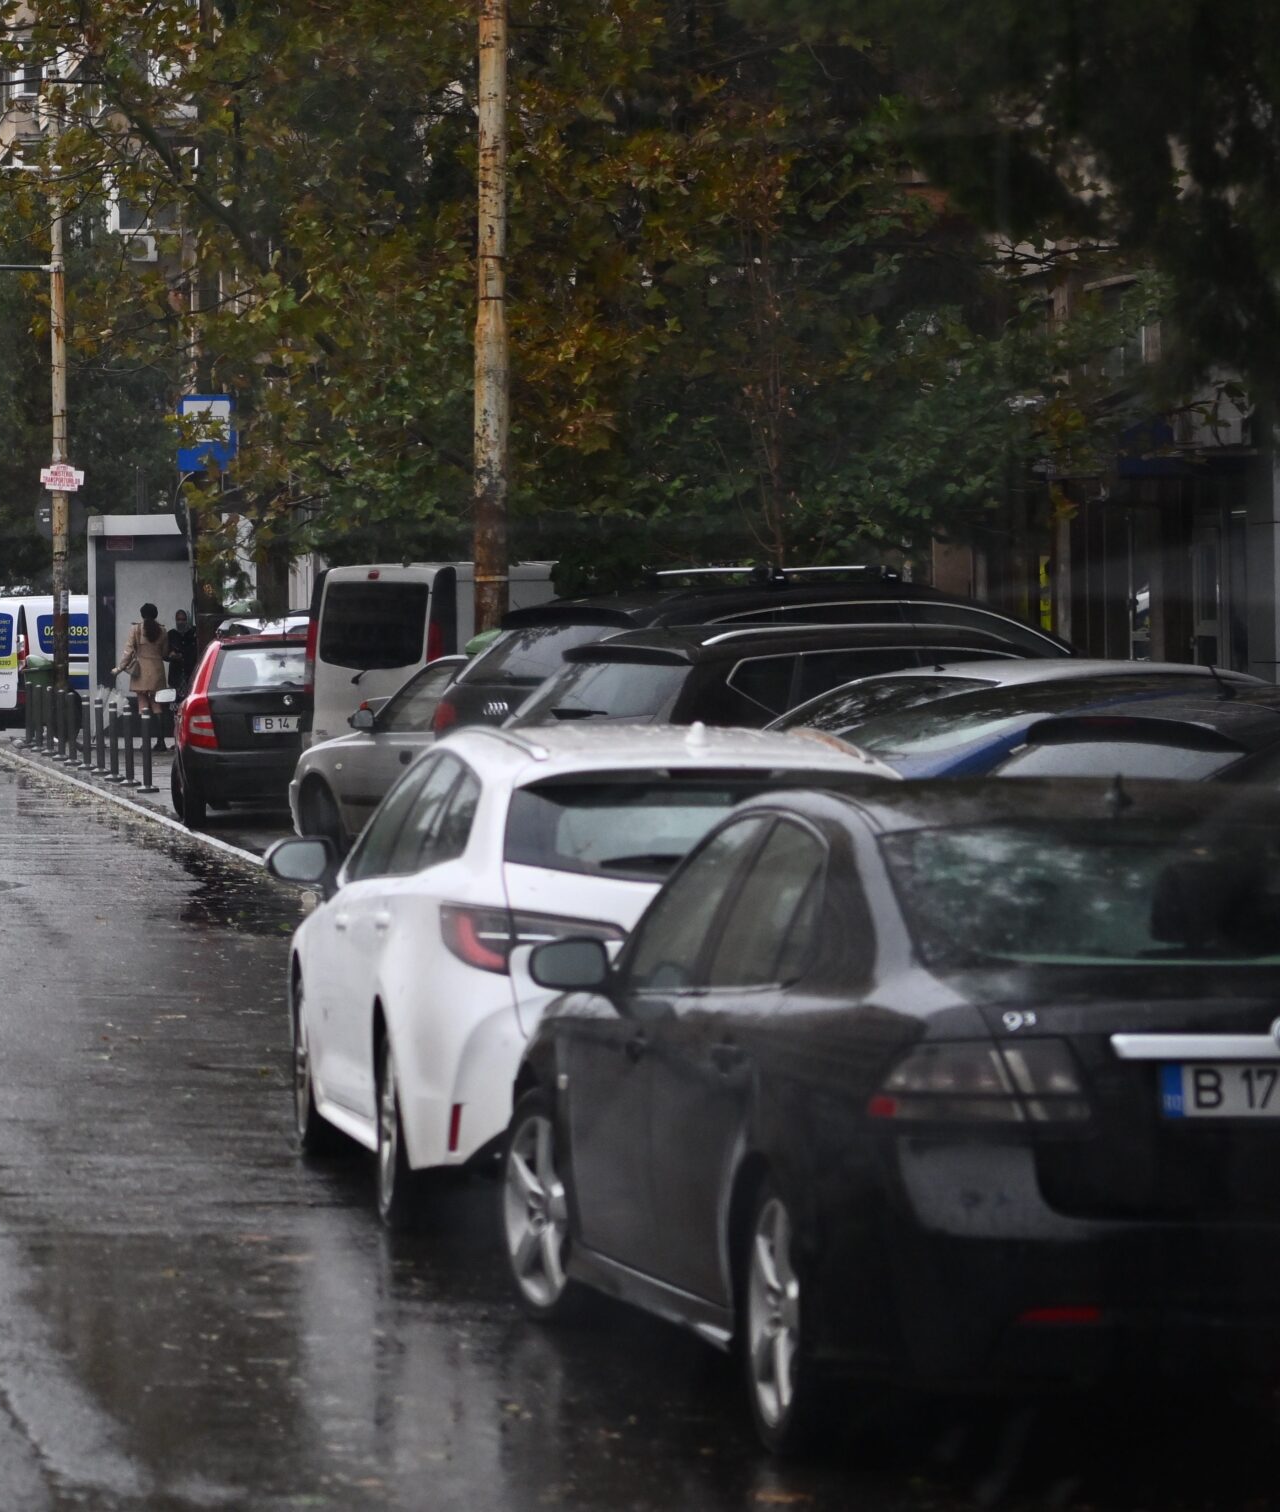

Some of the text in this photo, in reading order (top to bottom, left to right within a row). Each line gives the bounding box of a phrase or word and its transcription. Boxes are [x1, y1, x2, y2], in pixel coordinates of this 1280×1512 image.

[265, 718, 274, 730] B
[278, 718, 290, 729] 14
[1193, 1067, 1280, 1110] B 17
